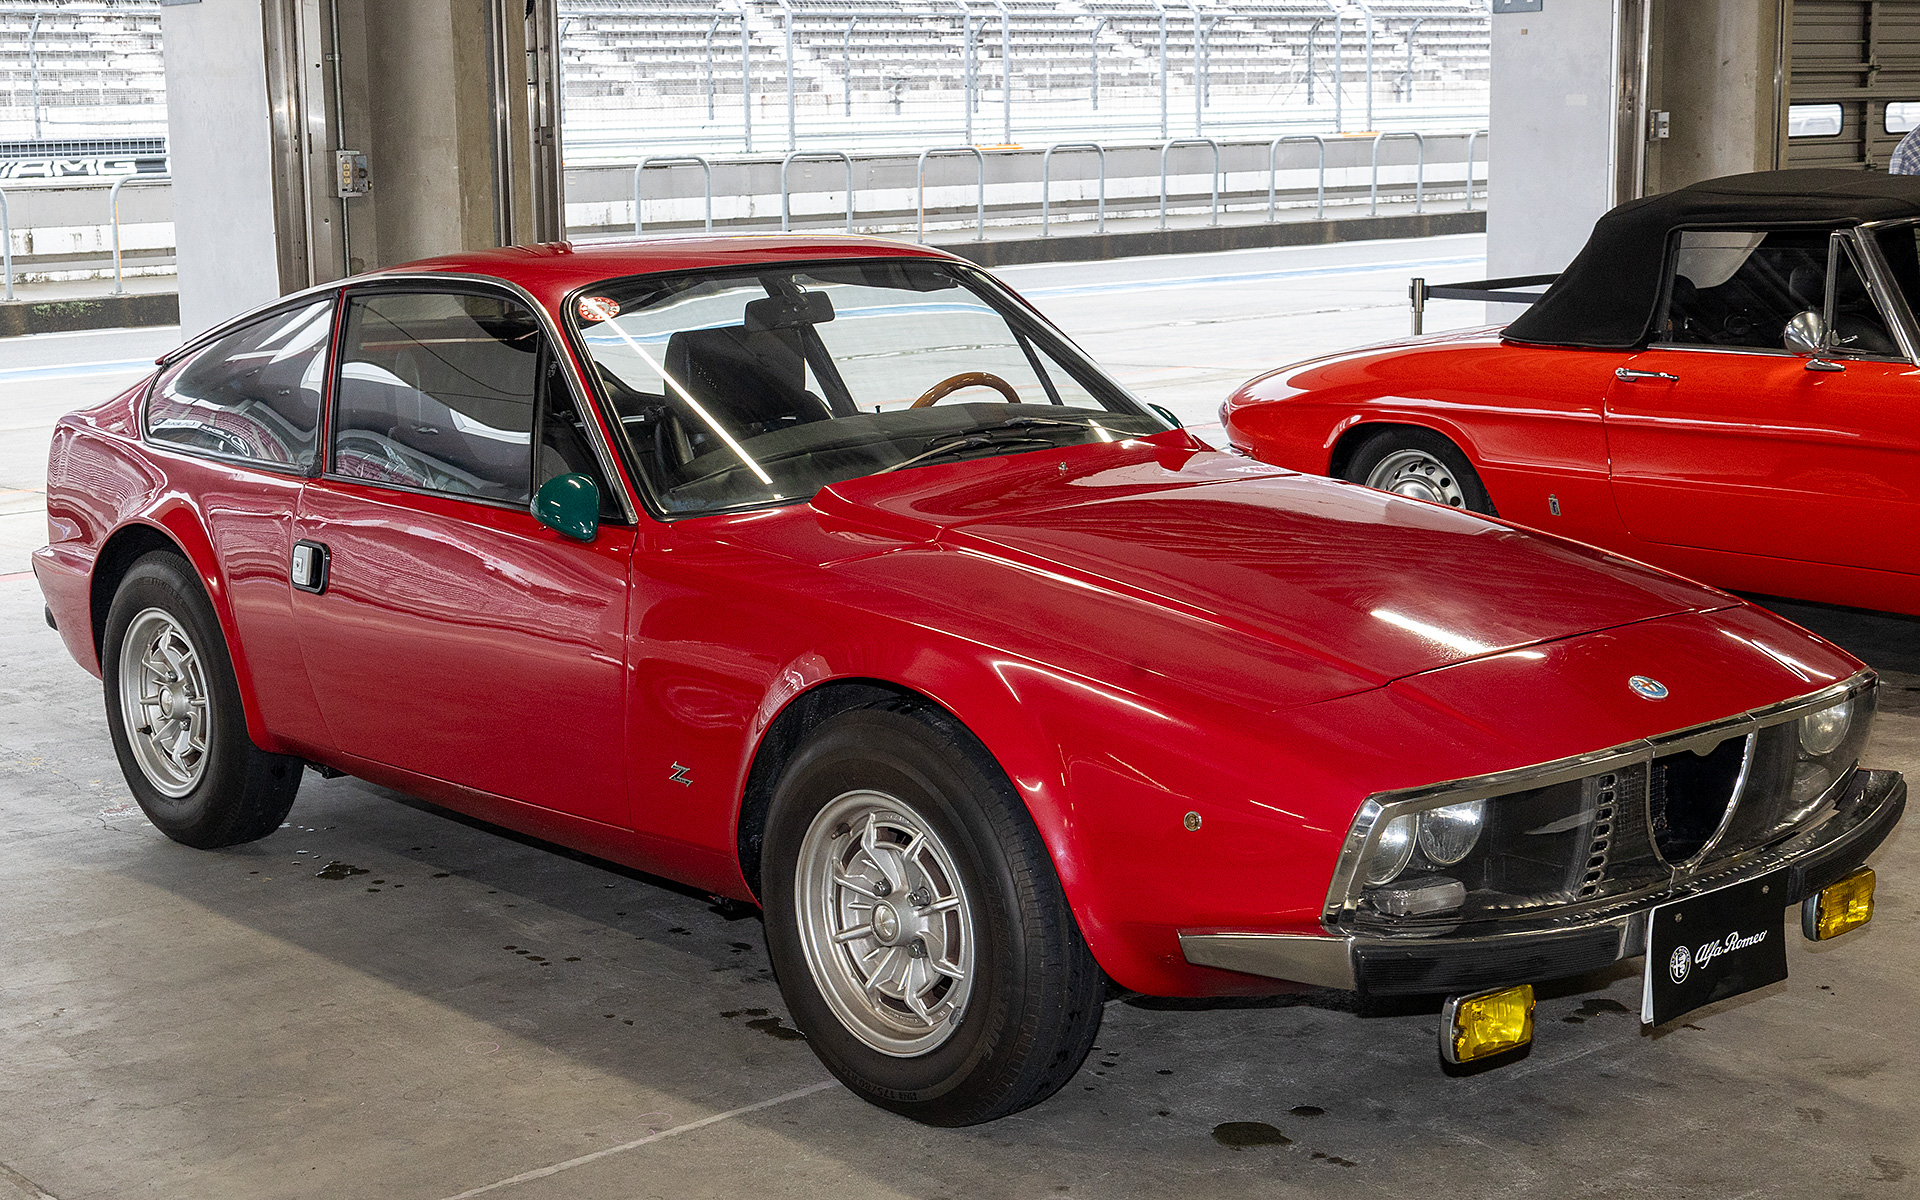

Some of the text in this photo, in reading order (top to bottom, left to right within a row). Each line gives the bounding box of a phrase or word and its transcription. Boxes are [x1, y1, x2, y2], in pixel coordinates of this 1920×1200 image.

[8, 158, 138, 178] AMG
[669, 761, 693, 787] Z
[1694, 939, 1723, 970] Alfa
[1722, 930, 1768, 953] Romeo
